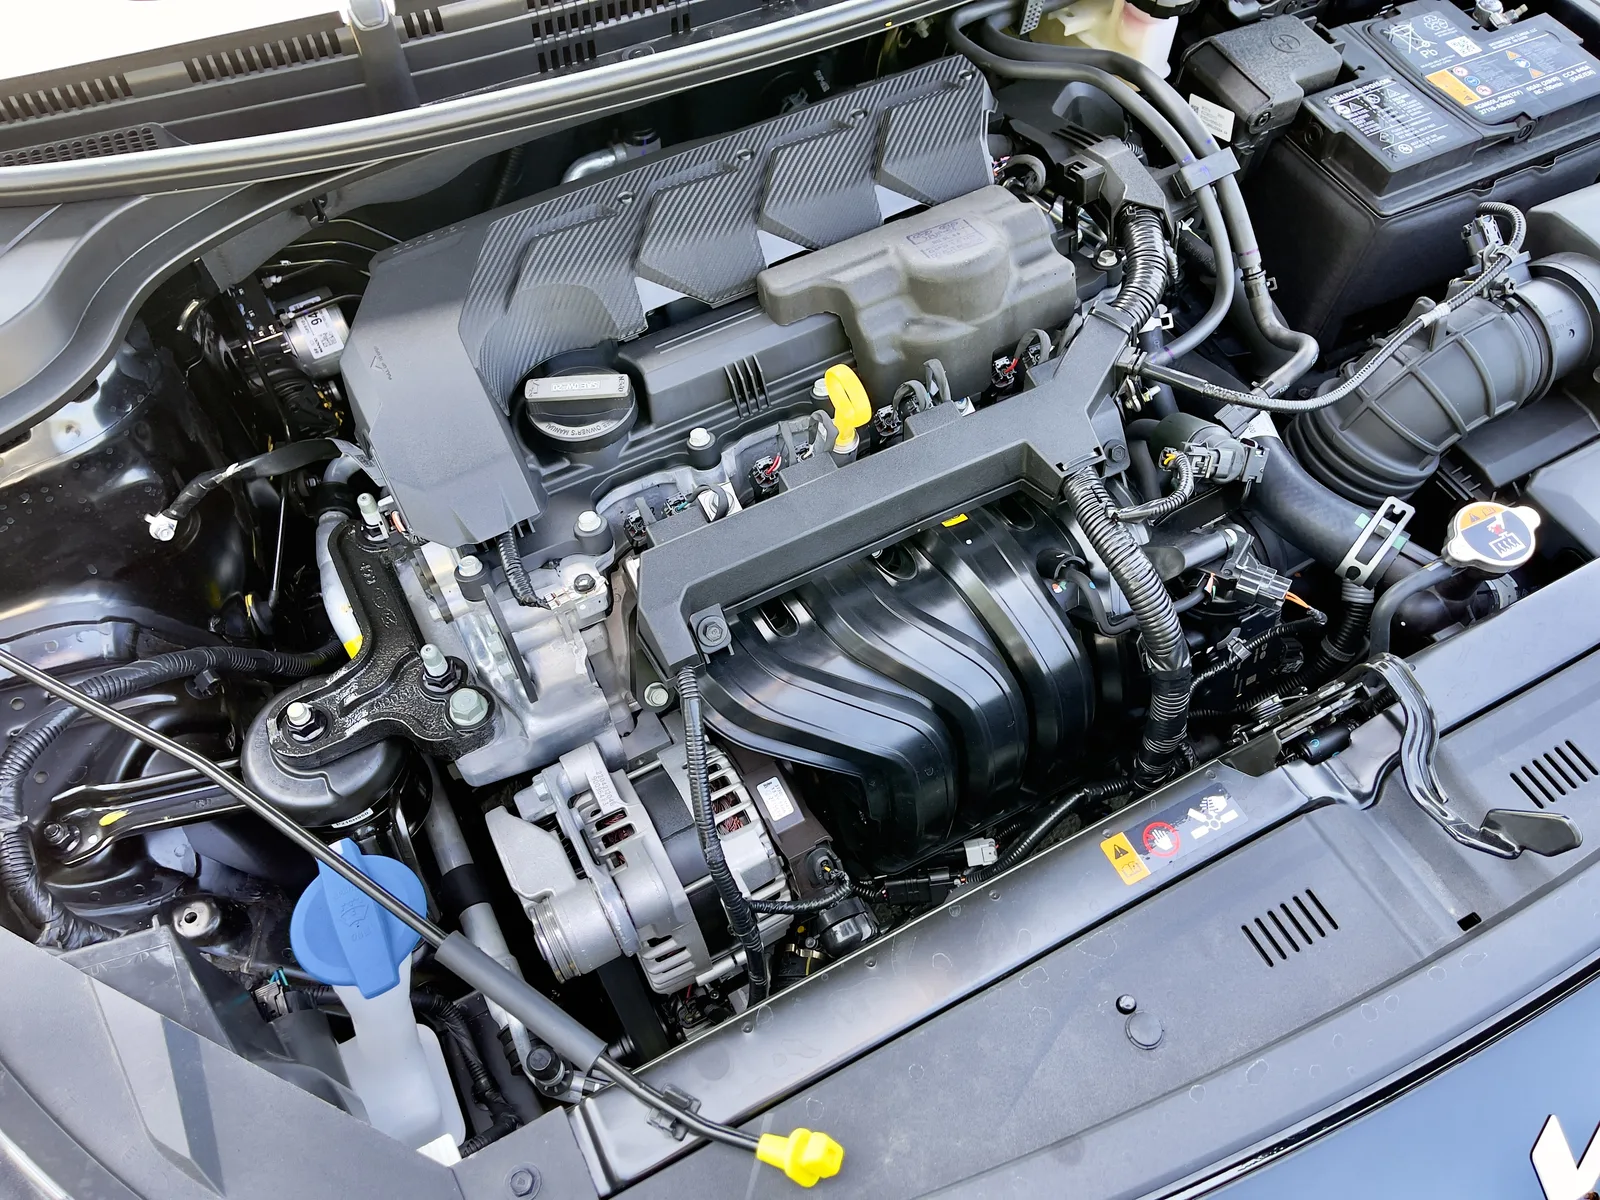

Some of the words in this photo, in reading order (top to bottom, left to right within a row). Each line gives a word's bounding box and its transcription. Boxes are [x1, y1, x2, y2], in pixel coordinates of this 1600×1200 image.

[1420, 48, 1438, 58] Pb
[546, 423, 570, 436] MANUAL
[571, 422, 602, 436] OWNER'S
